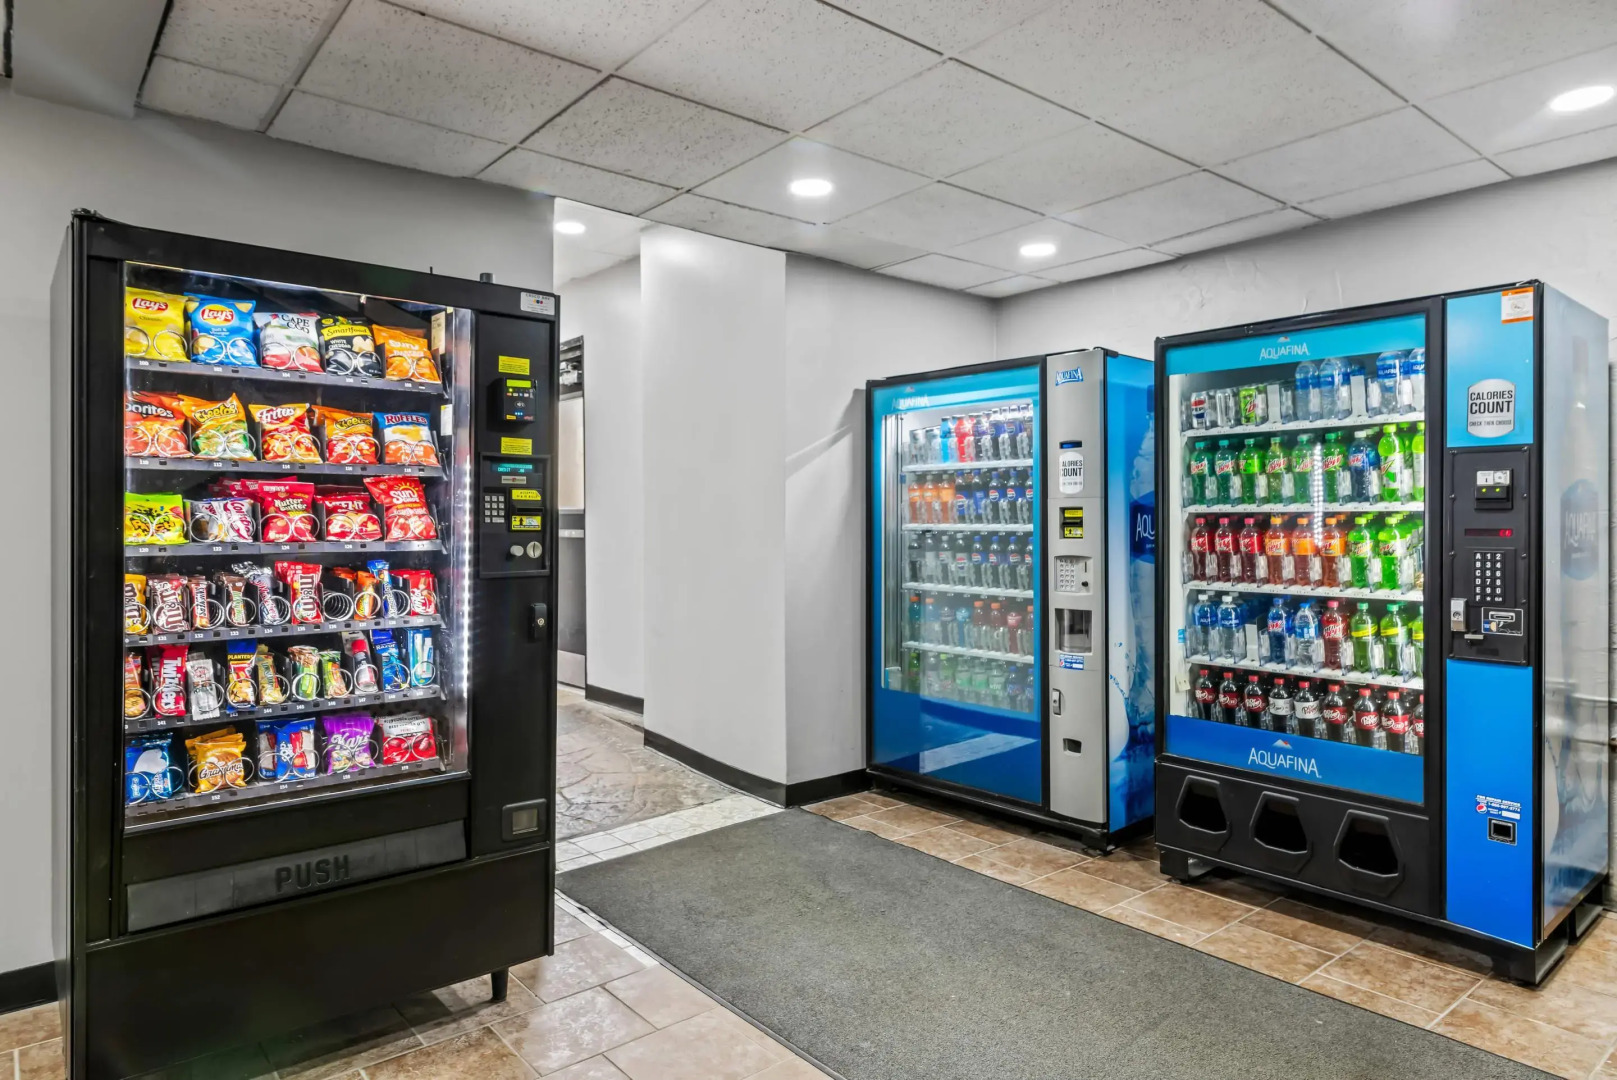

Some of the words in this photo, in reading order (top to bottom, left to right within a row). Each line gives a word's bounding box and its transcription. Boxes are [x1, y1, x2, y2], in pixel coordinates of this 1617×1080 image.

[132, 297, 167, 312] Lay's
[202, 308, 233, 324] Lay's
[281, 313, 310, 328] CAPE
[286, 320, 310, 335] COD
[326, 327, 368, 337] Smartfood
[1259, 342, 1310, 361] AQUAFINA
[1470, 390, 1513, 401] CALORIES
[194, 403, 238, 423] Cheetos
[256, 407, 295, 422] Fritos
[1470, 400, 1513, 415] COUNT
[384, 413, 428, 425] RUFFLES
[274, 498, 303, 508] Nutter
[389, 489, 417, 504] Sun
[280, 503, 307, 512] Butter
[1475, 552, 1482, 560] A
[1486, 552, 1491, 560] 1
[1475, 569, 1481, 577] C
[1495, 578, 1501, 586] 8
[1475, 586, 1481, 594] E
[1475, 594, 1481, 602] F
[161, 656, 183, 710] Twizzlers
[330, 733, 371, 749] Kar's
[1248, 747, 1323, 779] AQUAFINA
[274, 854, 351, 895] PUSH
